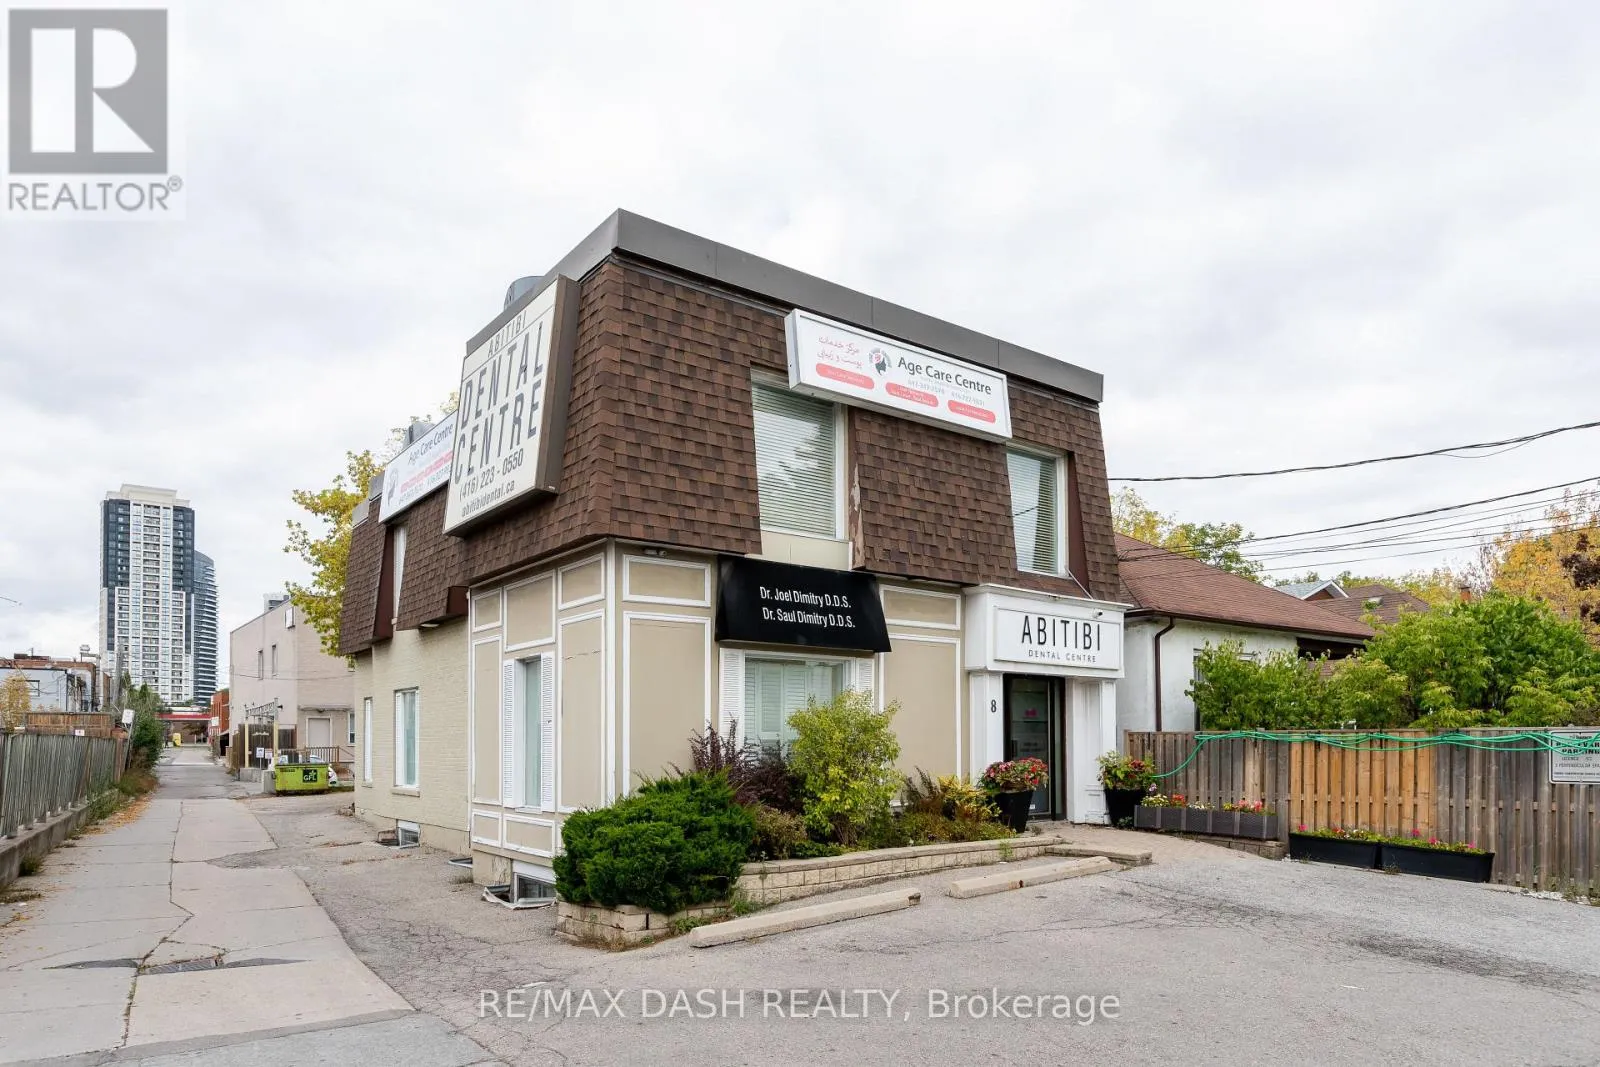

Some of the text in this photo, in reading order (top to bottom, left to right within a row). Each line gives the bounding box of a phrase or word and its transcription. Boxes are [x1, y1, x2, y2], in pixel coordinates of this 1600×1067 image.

[488, 310, 526, 357] ABITIBI
[461, 321, 543, 430] DENTAL
[898, 357, 922, 375] Age
[925, 366, 952, 383] Care
[955, 374, 991, 394] Centre
[420, 439, 433, 456] Care
[433, 423, 454, 446] Centre
[455, 379, 542, 484] CENTRE
[459, 476, 479, 503] (416)
[480, 465, 495, 489] 223
[502, 448, 524, 476] 0550
[759, 586, 852, 608] Dr. Joel Dimitry D.D.S.
[762, 607, 856, 628] Dr. Saul Dimitry D.D.S.
[1021, 615, 1100, 651] ABITIBI
[1028, 649, 1096, 663] DENTAL CENTRE
[990, 699, 998, 713] 8
